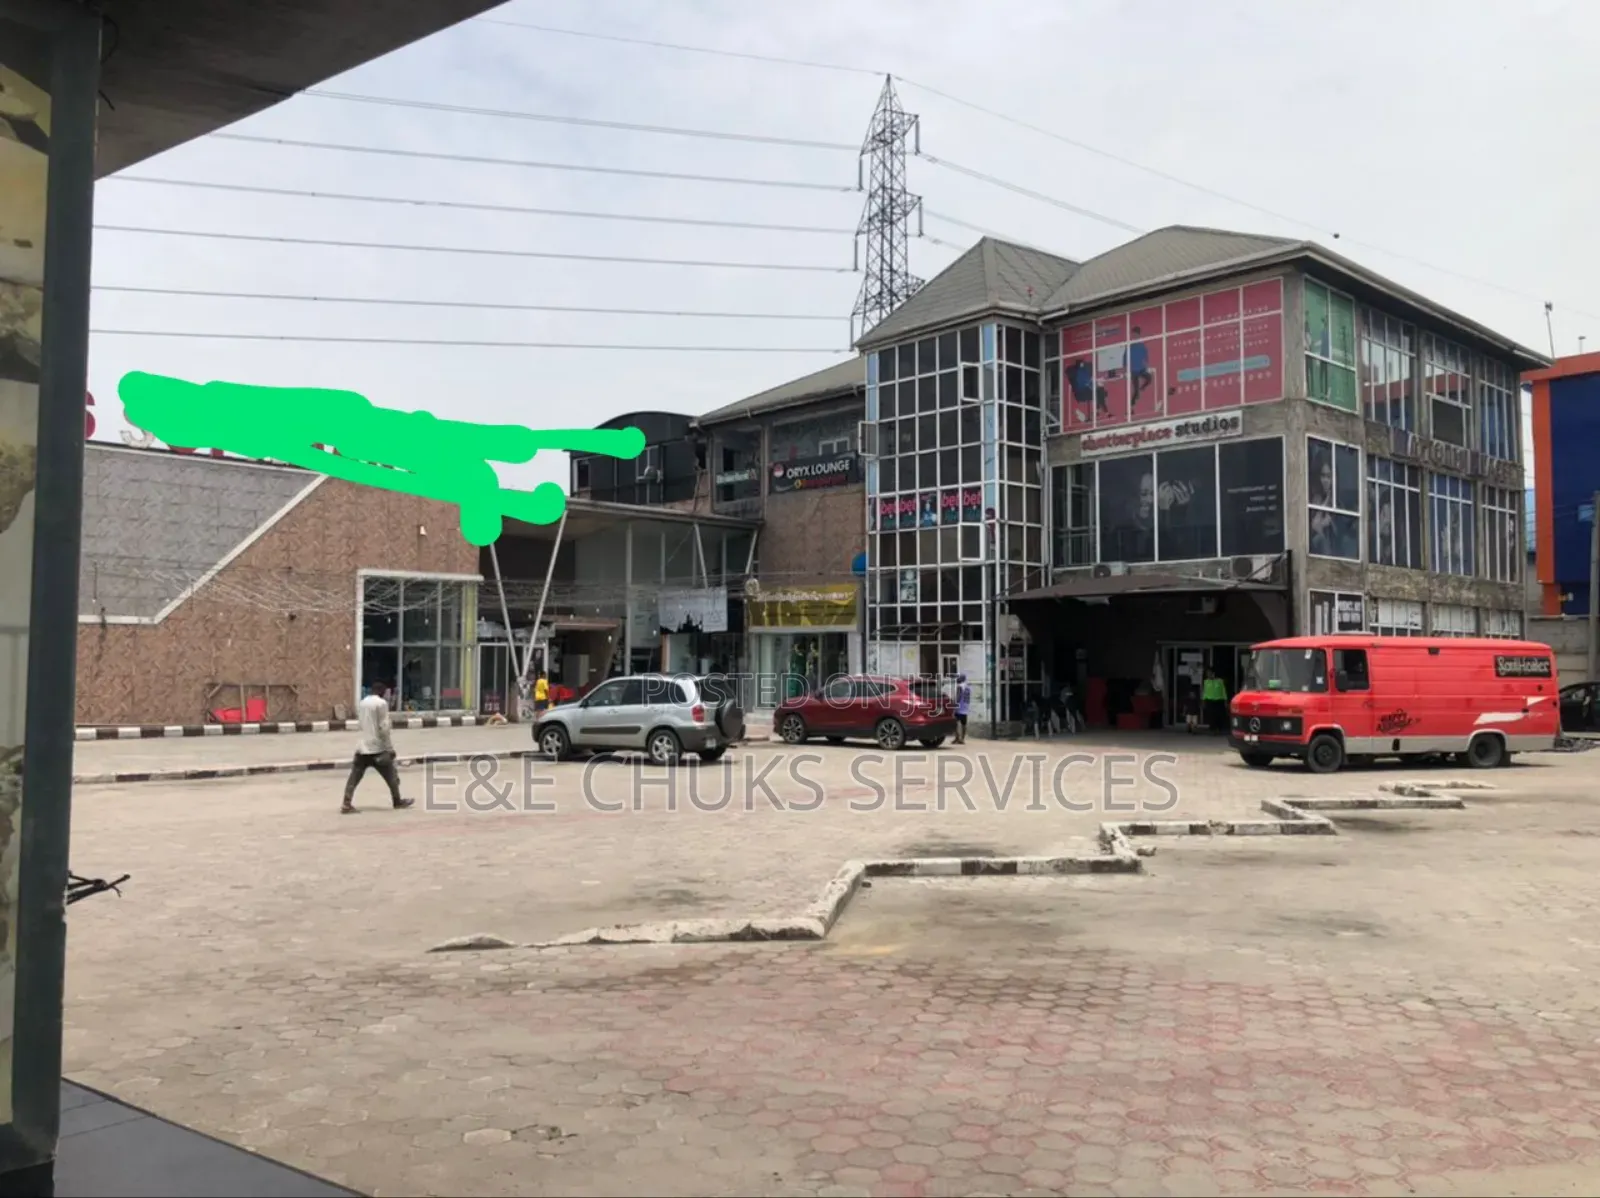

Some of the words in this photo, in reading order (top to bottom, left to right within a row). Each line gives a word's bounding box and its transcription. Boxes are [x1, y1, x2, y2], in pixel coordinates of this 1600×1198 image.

[1175, 416, 1240, 437] studios
[787, 465, 810, 479] ORYX
[811, 459, 850, 476] LOUNGE
